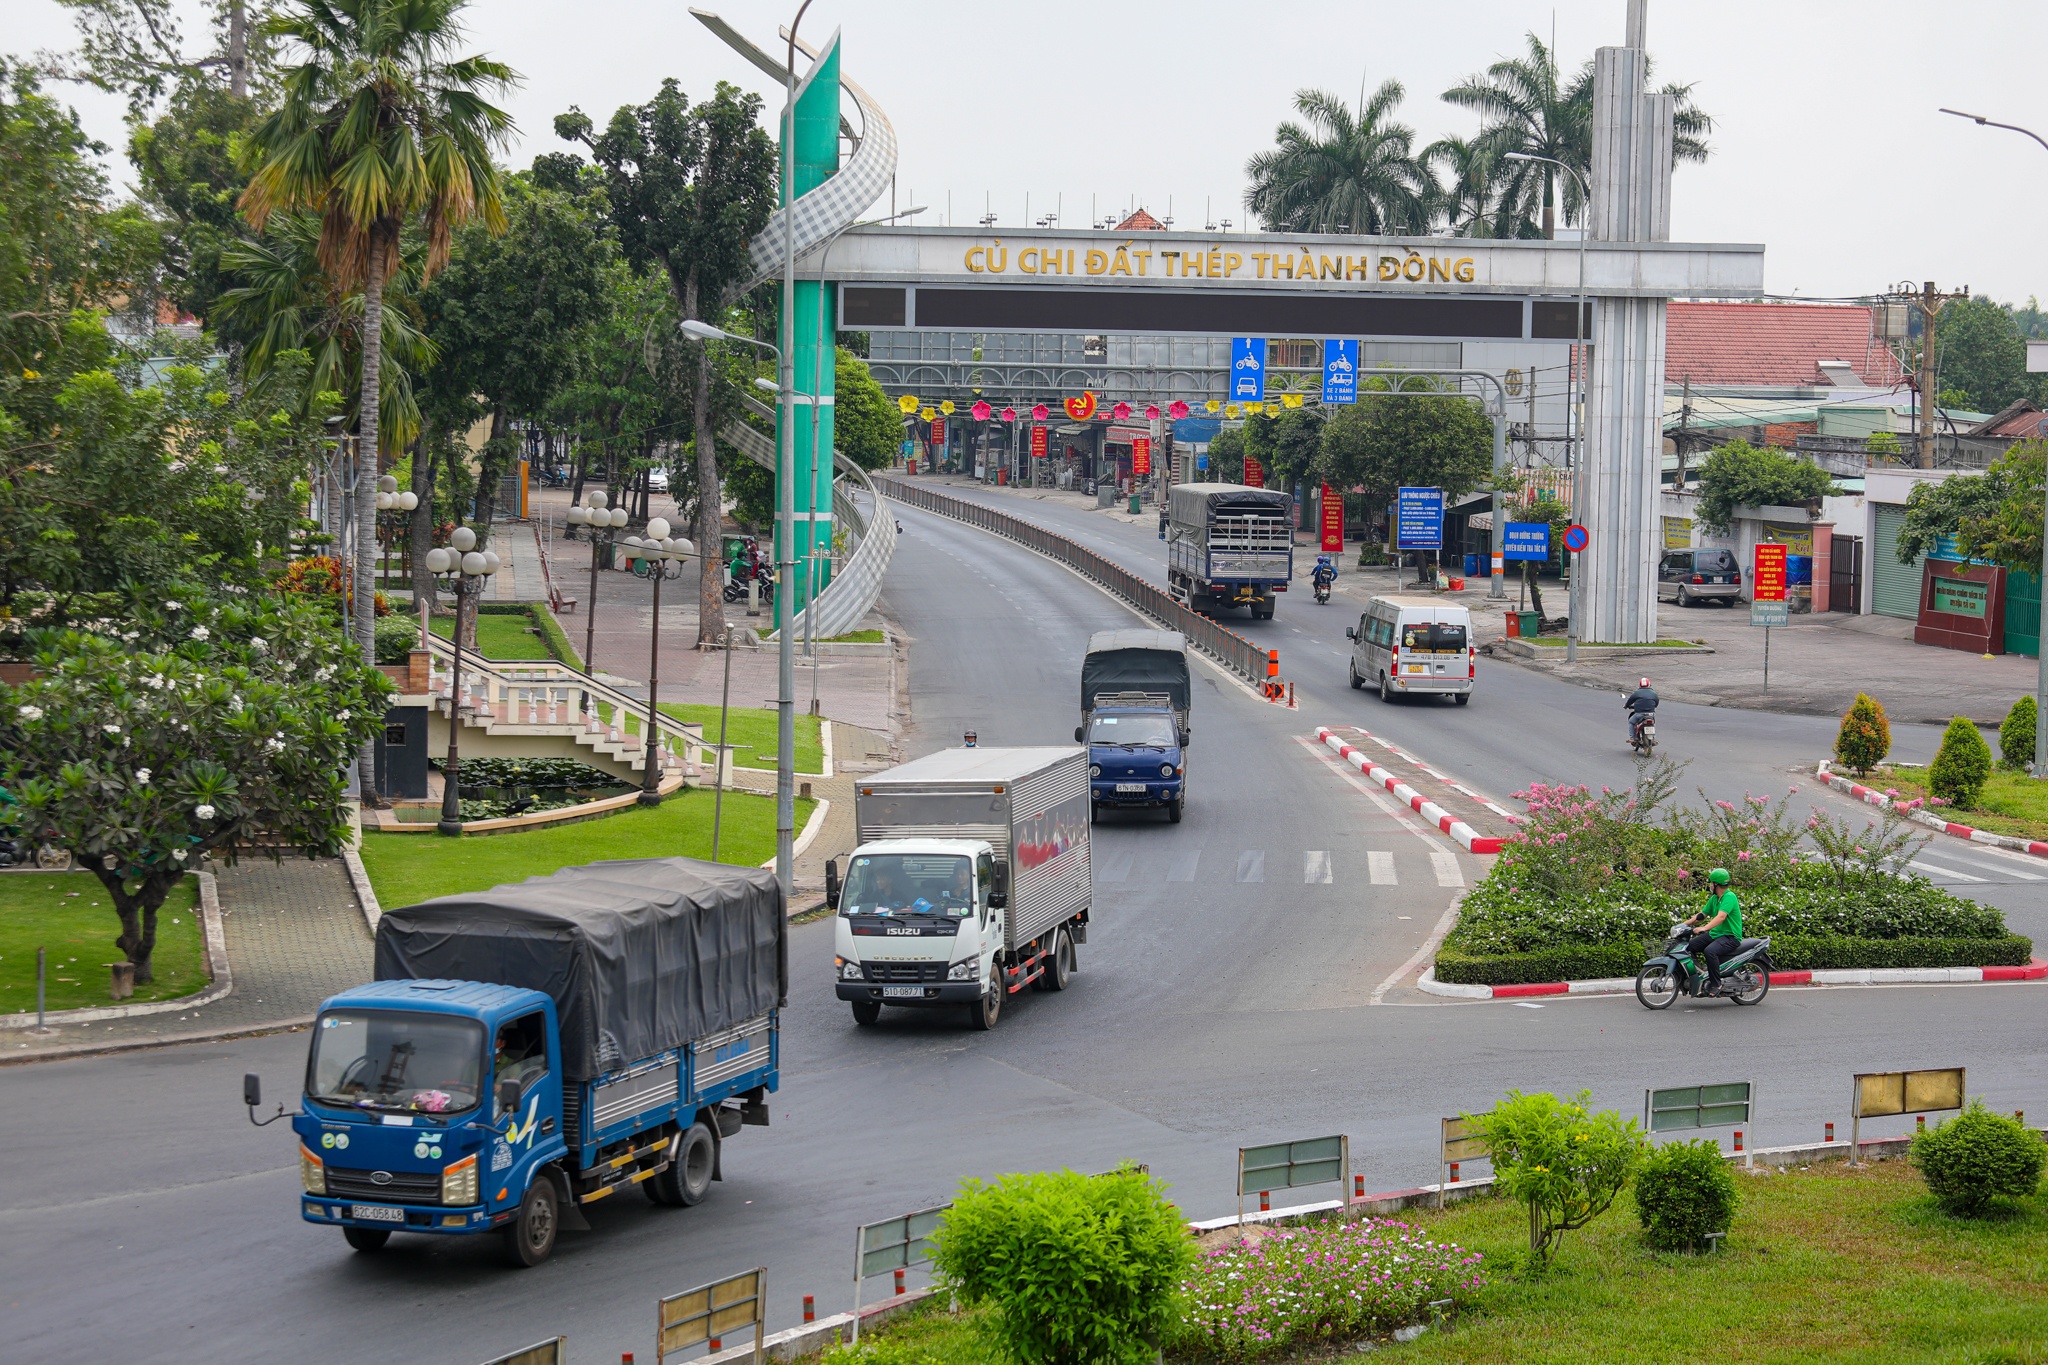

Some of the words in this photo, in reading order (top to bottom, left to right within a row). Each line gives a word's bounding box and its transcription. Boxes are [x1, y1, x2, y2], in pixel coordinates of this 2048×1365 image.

[964, 239, 1007, 273] CỦ
[1018, 247, 1074, 274] CHI
[1084, 240, 1152, 276] ĐẤT
[1160, 244, 1242, 278] THÉP
[1252, 246, 1367, 281] THÀNH
[1377, 245, 1475, 282] ĐỒNG
